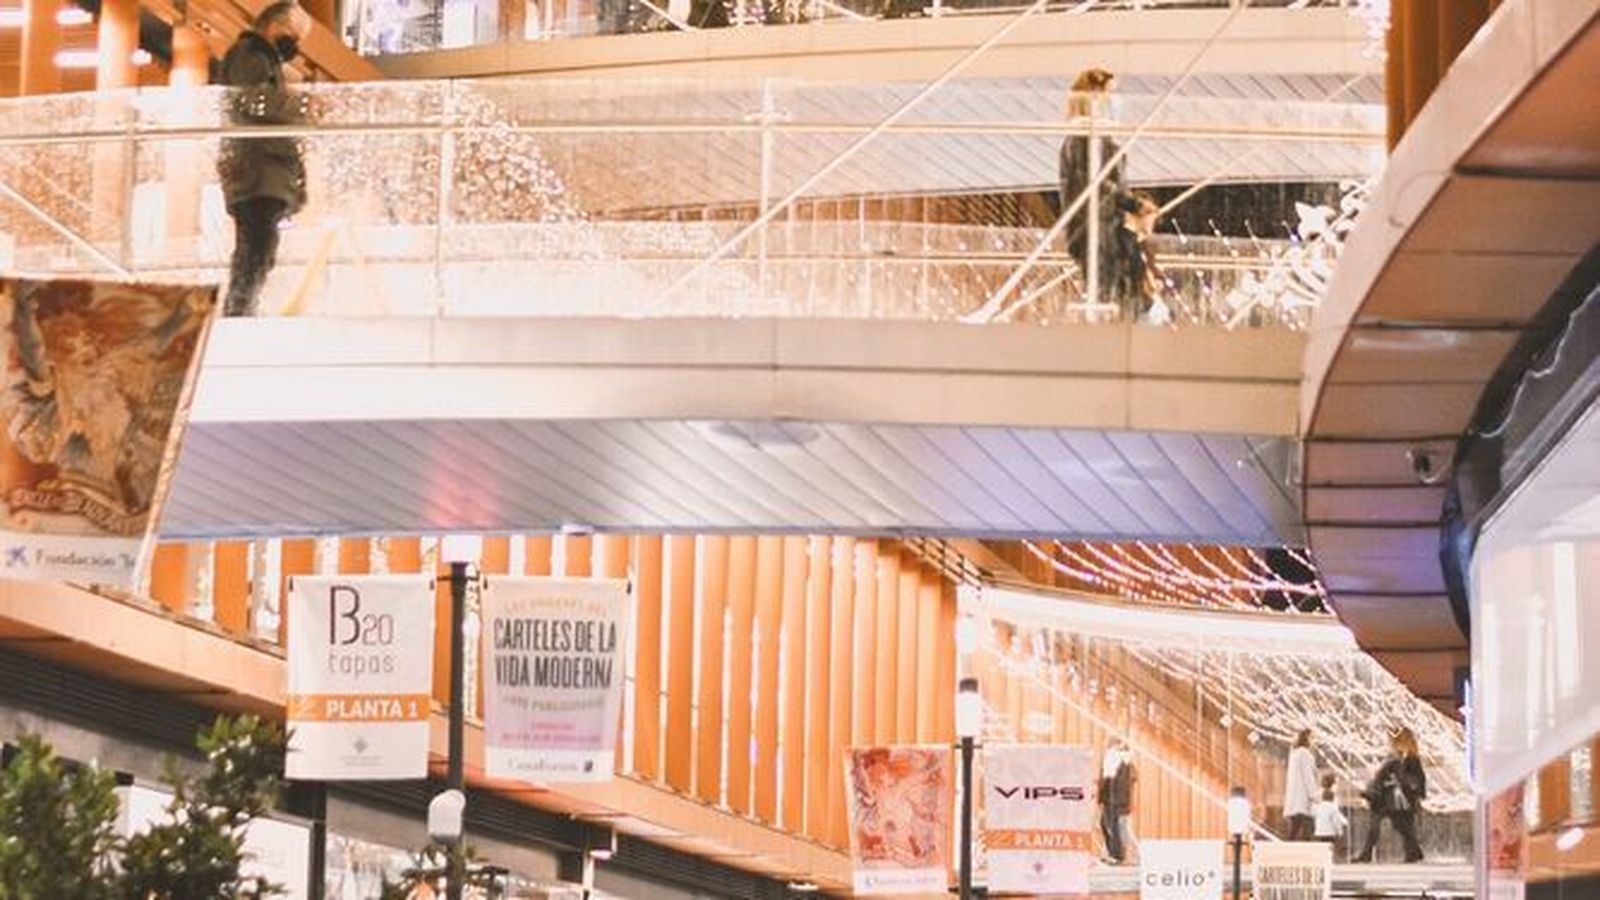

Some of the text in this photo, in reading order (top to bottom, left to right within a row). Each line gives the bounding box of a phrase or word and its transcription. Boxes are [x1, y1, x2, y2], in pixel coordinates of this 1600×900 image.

[493, 618, 617, 653] CARTELES DE LA
[328, 652, 395, 679] tapas
[494, 655, 530, 687] VIDA
[326, 699, 418, 718] PLANTA 1
[994, 786, 1084, 801] VIPS
[1014, 832, 1073, 849] PLANTA
